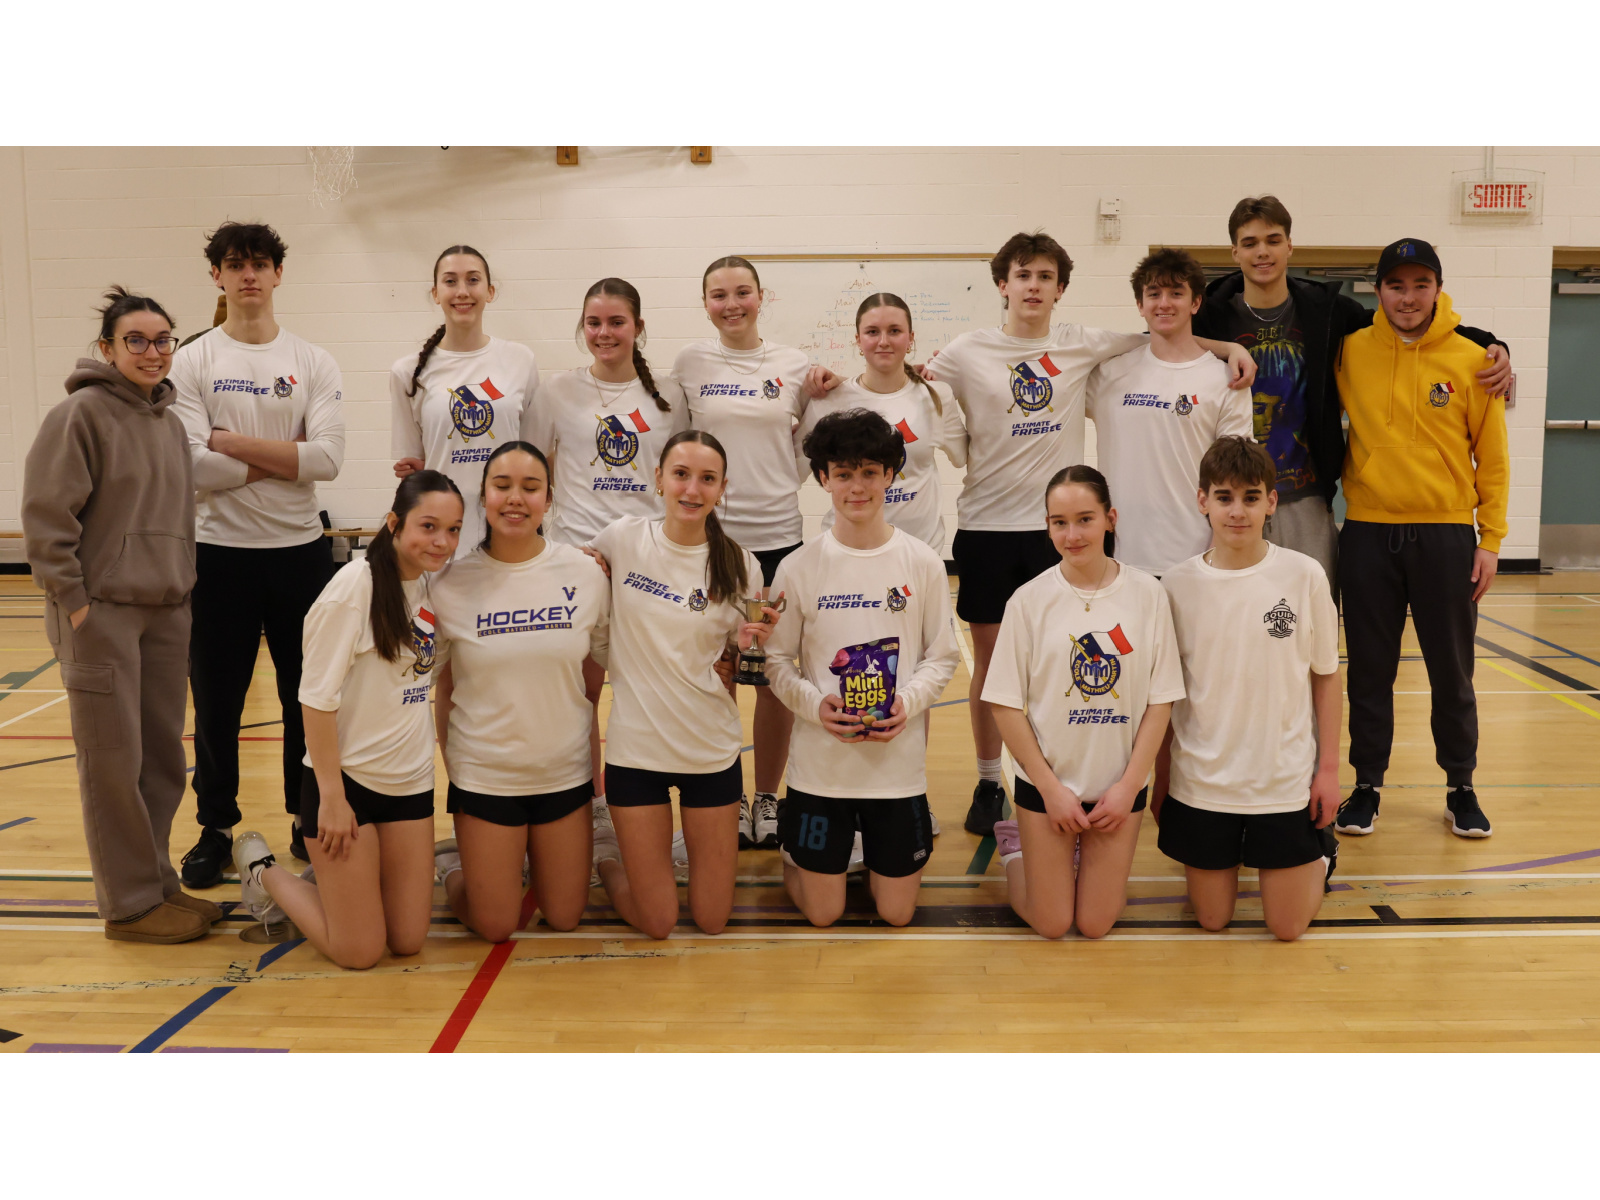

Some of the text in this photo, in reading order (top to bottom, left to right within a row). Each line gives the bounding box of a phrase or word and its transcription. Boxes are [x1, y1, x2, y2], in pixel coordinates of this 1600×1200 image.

[1473, 184, 1528, 208] SORTIE
[213, 379, 255, 387] ULTIMATE
[213, 384, 271, 395] FRISBEE
[700, 389, 758, 398] FRISBEE
[1124, 393, 1160, 401] ULTIMATE
[1122, 399, 1172, 409] FRISBEE
[1011, 423, 1062, 437] FRISBEE
[1012, 420, 1051, 429] ULTIMATE
[451, 447, 492, 456] ULTIMATE
[451, 454, 490, 464] FRISB
[592, 483, 648, 492] FRISBEE
[884, 492, 918, 504] SBEE
[627, 571, 670, 592] ULTIMATE
[623, 578, 684, 604] FRISBEE
[817, 594, 864, 602] ULTIMATE
[817, 600, 882, 611] FRISBEE
[476, 605, 578, 629] HOCKEY
[845, 670, 884, 692] Mini
[403, 685, 429, 696] ULTIMAT
[402, 693, 426, 705] FRIS
[845, 689, 887, 709] Eggs
[1069, 708, 1114, 716] ULTIMATE
[1068, 715, 1130, 725] FRISBEE
[798, 812, 829, 851] 18
